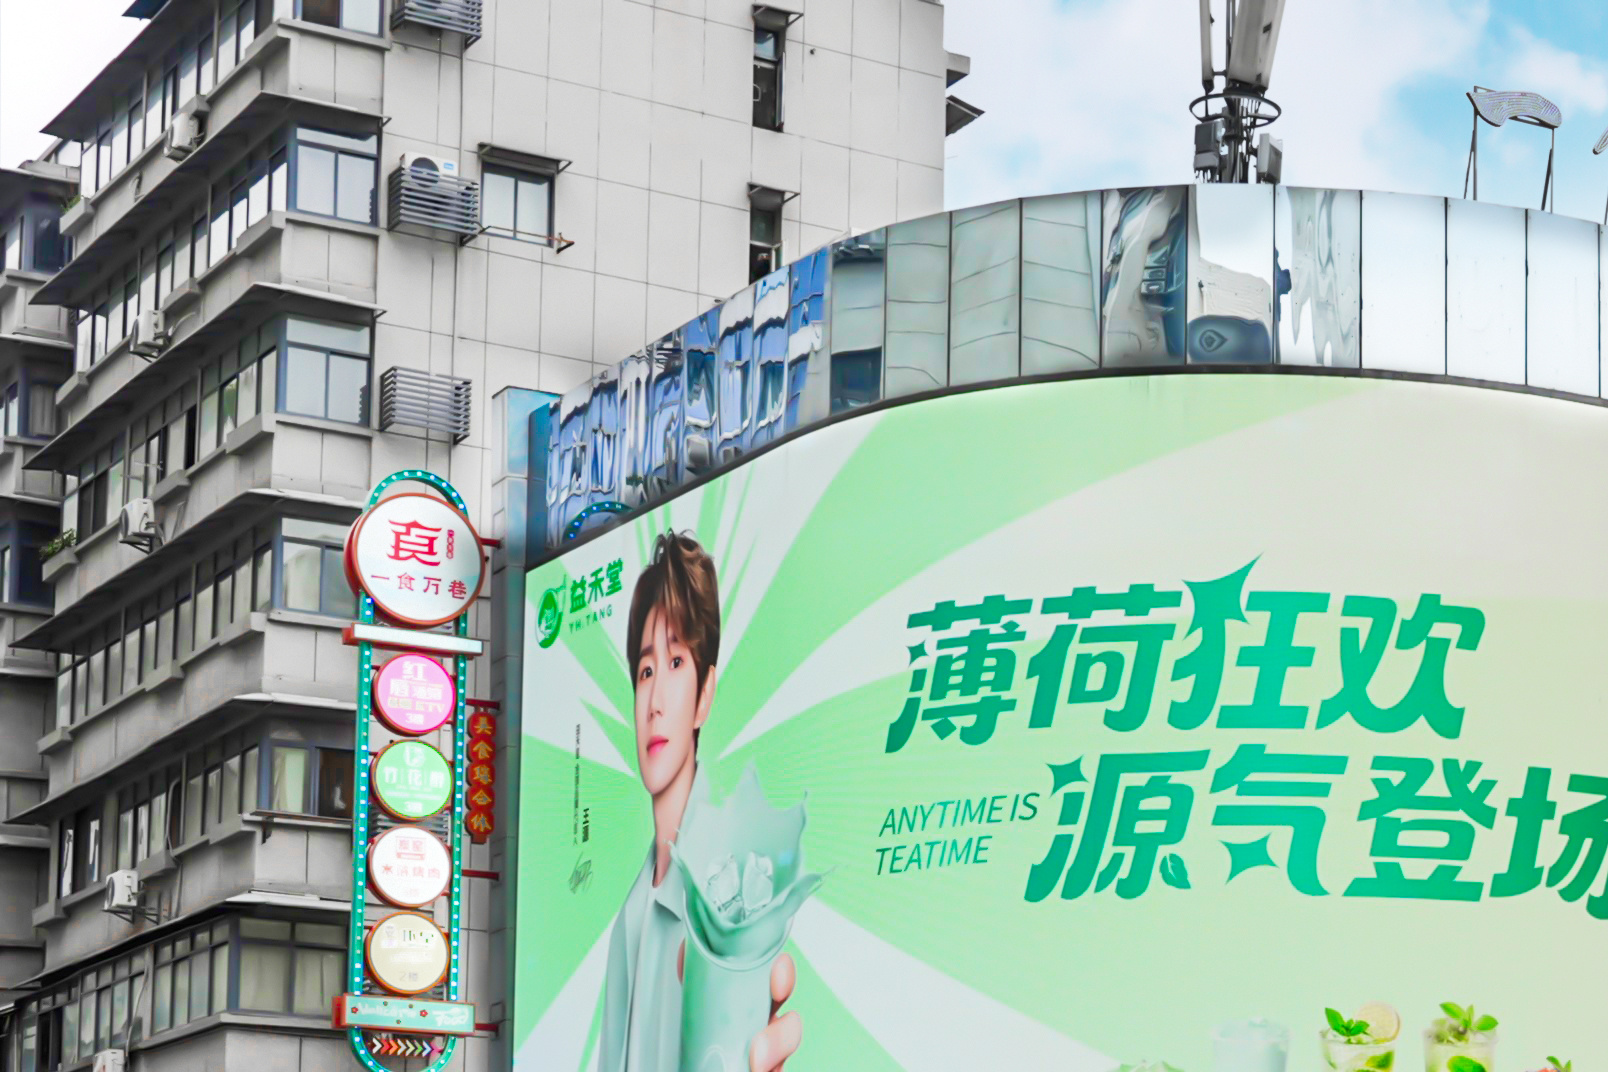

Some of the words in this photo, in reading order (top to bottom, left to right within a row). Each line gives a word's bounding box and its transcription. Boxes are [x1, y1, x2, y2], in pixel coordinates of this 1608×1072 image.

[371, 572, 467, 600] 一食万巷
[569, 558, 623, 613] 益禾堂
[885, 552, 1486, 754] 薄荷狂欢
[879, 795, 1006, 837] ANYTIME
[1009, 792, 1040, 821] IS
[874, 836, 993, 876] TEATIME
